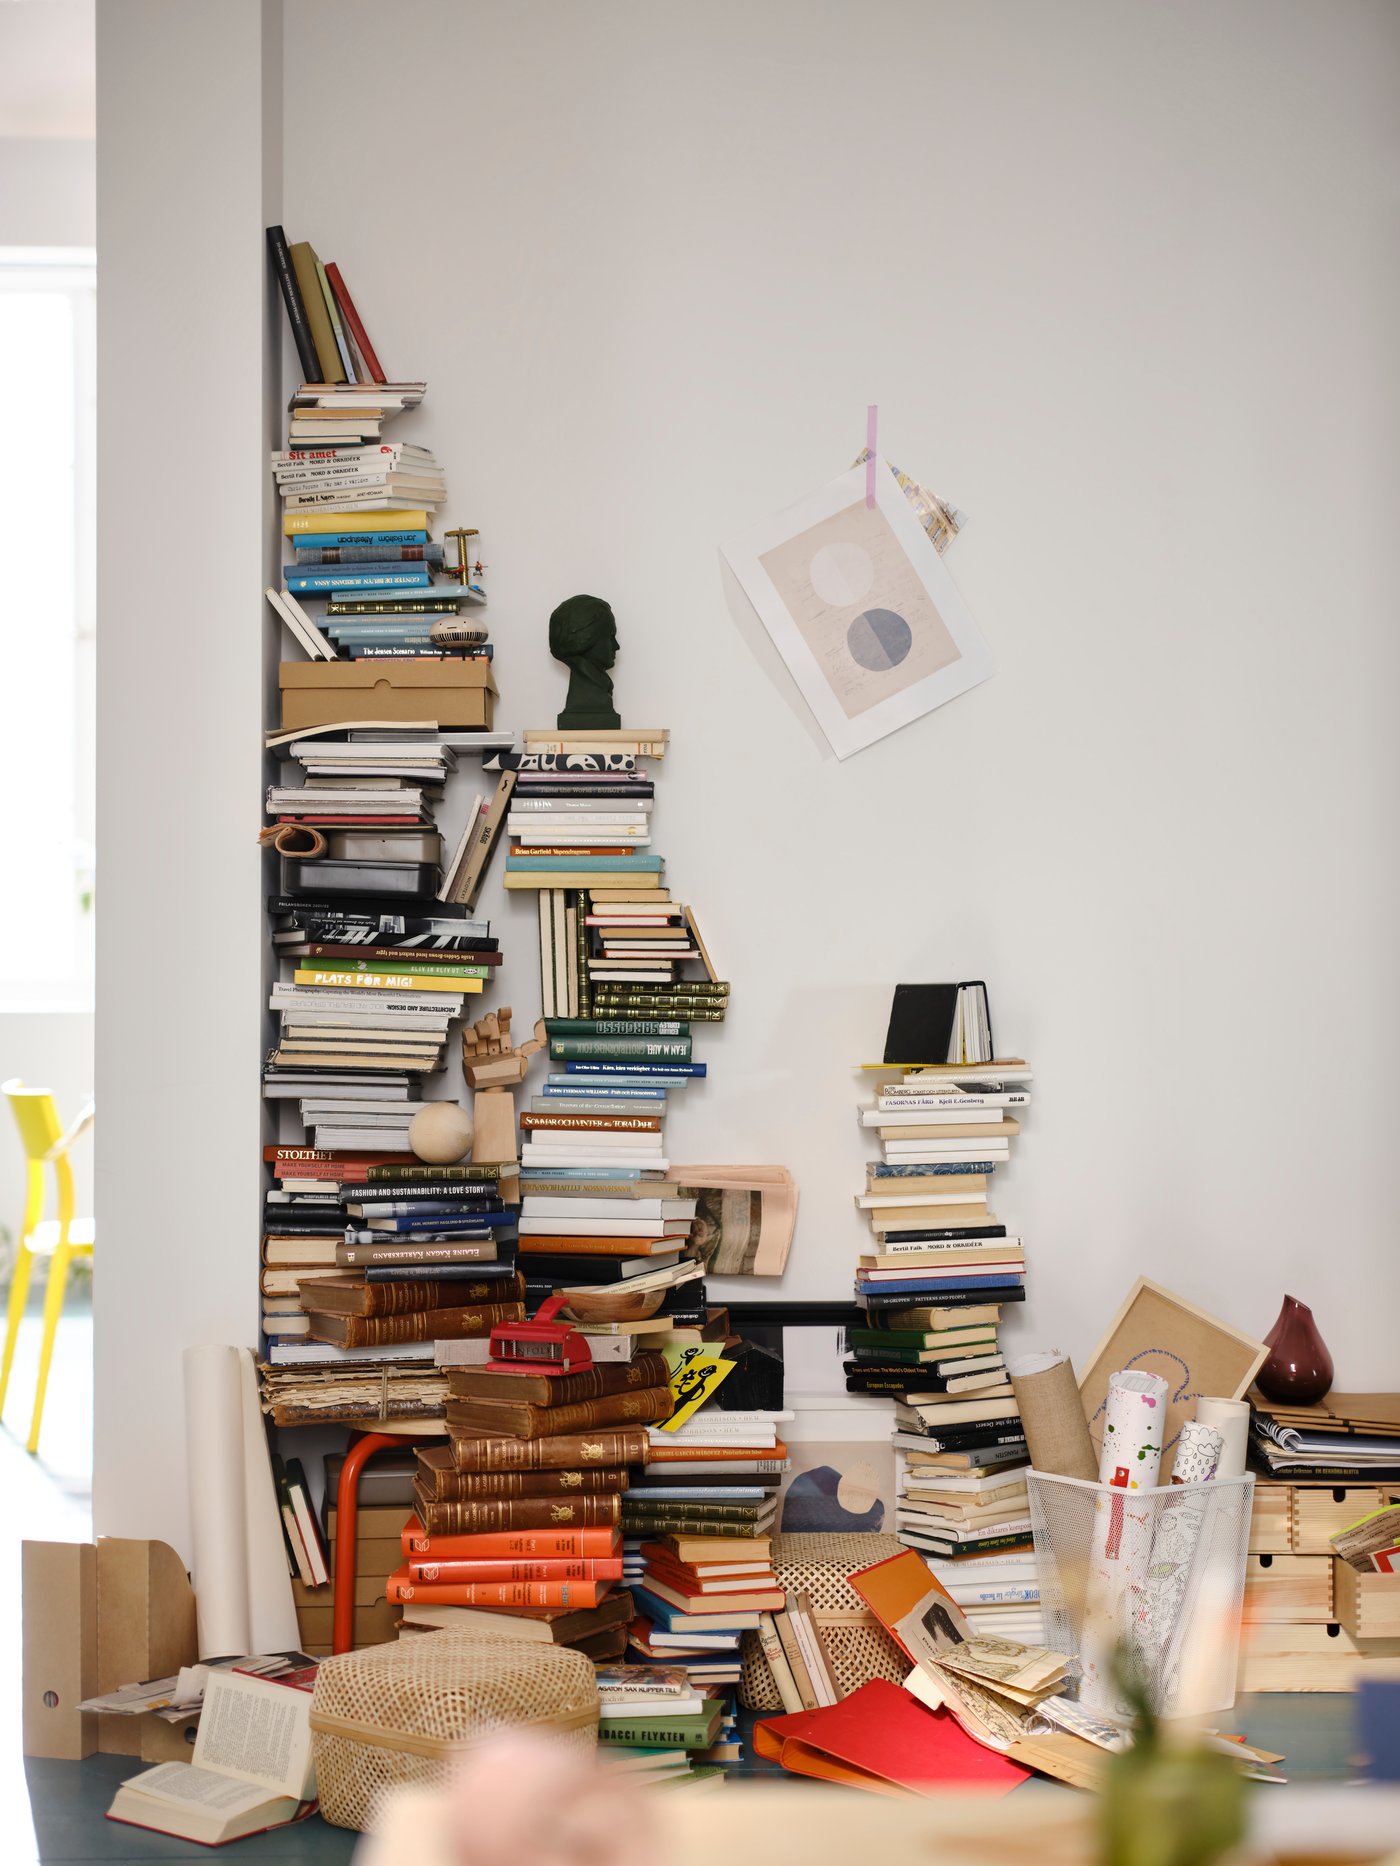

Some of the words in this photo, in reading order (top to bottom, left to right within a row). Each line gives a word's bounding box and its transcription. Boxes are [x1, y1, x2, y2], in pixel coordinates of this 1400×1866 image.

[289, 451, 306, 460] Sit
[309, 450, 337, 460] amet
[299, 496, 316, 504] Dorothy
[320, 494, 336, 502] Sayers
[337, 536, 374, 544] Ättestupan
[378, 535, 404, 543] Ekström
[406, 534, 416, 543] Jan
[364, 647, 373, 655] The
[392, 647, 416, 655] Scenario
[480, 826, 492, 844] SKÄGG
[460, 876, 472, 900] NICOTEXT
[314, 974, 352, 985] PLATS
[356, 974, 382, 986] FÖR
[386, 976, 413, 987] MIG!
[418, 1005, 456, 1013] ARCHITECTURE
[596, 1020, 659, 1035] SARGASSO
[646, 1044, 662, 1055] AUEL
[670, 1044, 686, 1056] JEAN
[525, 1116, 557, 1125] SOMMAR
[574, 1118, 602, 1127] VINTER
[612, 1120, 632, 1128] TORA
[632, 1120, 655, 1129] DAHL
[277, 1150, 333, 1160] STOLTHET
[392, 1187, 442, 1196] SUSTAINABILITY:
[449, 1186, 464, 1194] LOVE
[466, 1186, 484, 1194] STORY
[866, 1382, 884, 1390] European
[884, 1382, 904, 1390] Escapades
[976, 1420, 994, 1428] Desert
[630, 1444, 639, 1455] 10
[642, 1730, 685, 1742] FLYKTEN
